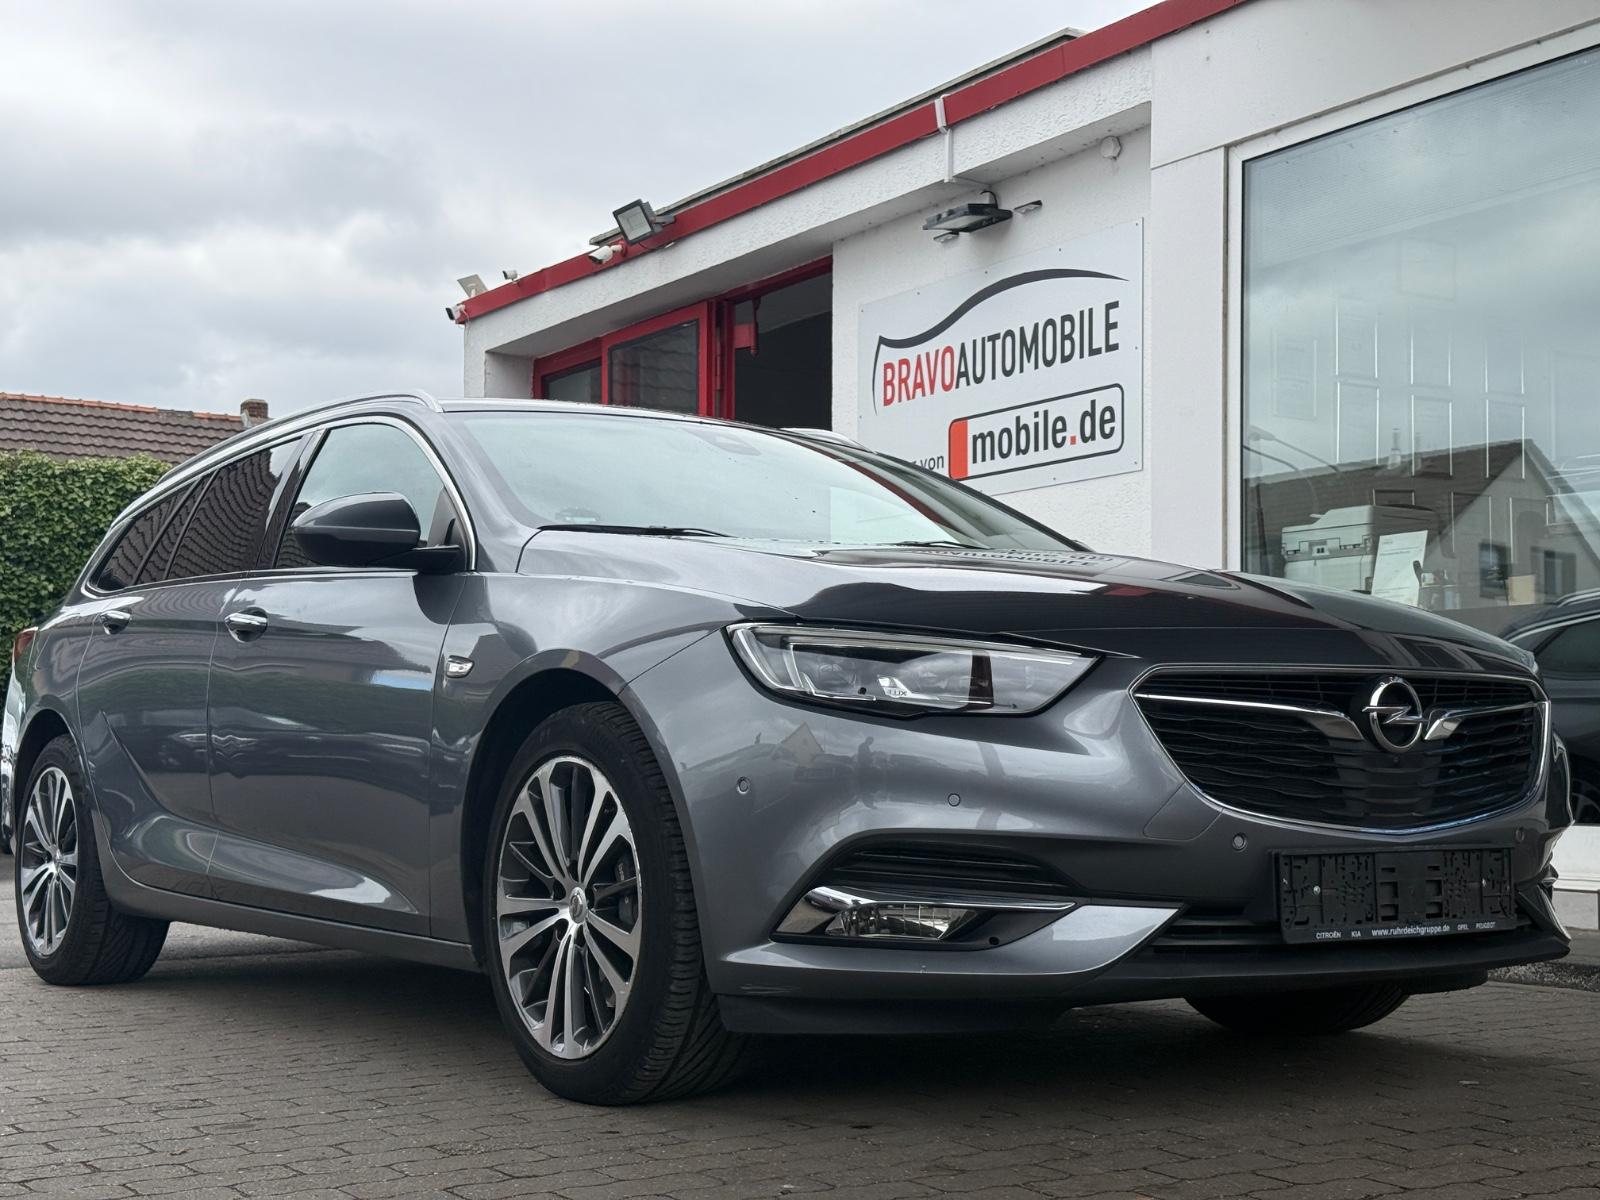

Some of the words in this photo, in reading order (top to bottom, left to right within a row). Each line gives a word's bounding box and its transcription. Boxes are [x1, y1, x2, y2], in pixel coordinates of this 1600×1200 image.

[883, 300, 1119, 407] BRAVOAUTOMOBILE
[920, 456, 944, 471] von
[972, 399, 1116, 464] mobile.de
[1371, 924, 1450, 936] www.ruhrdeichgruppe.de
